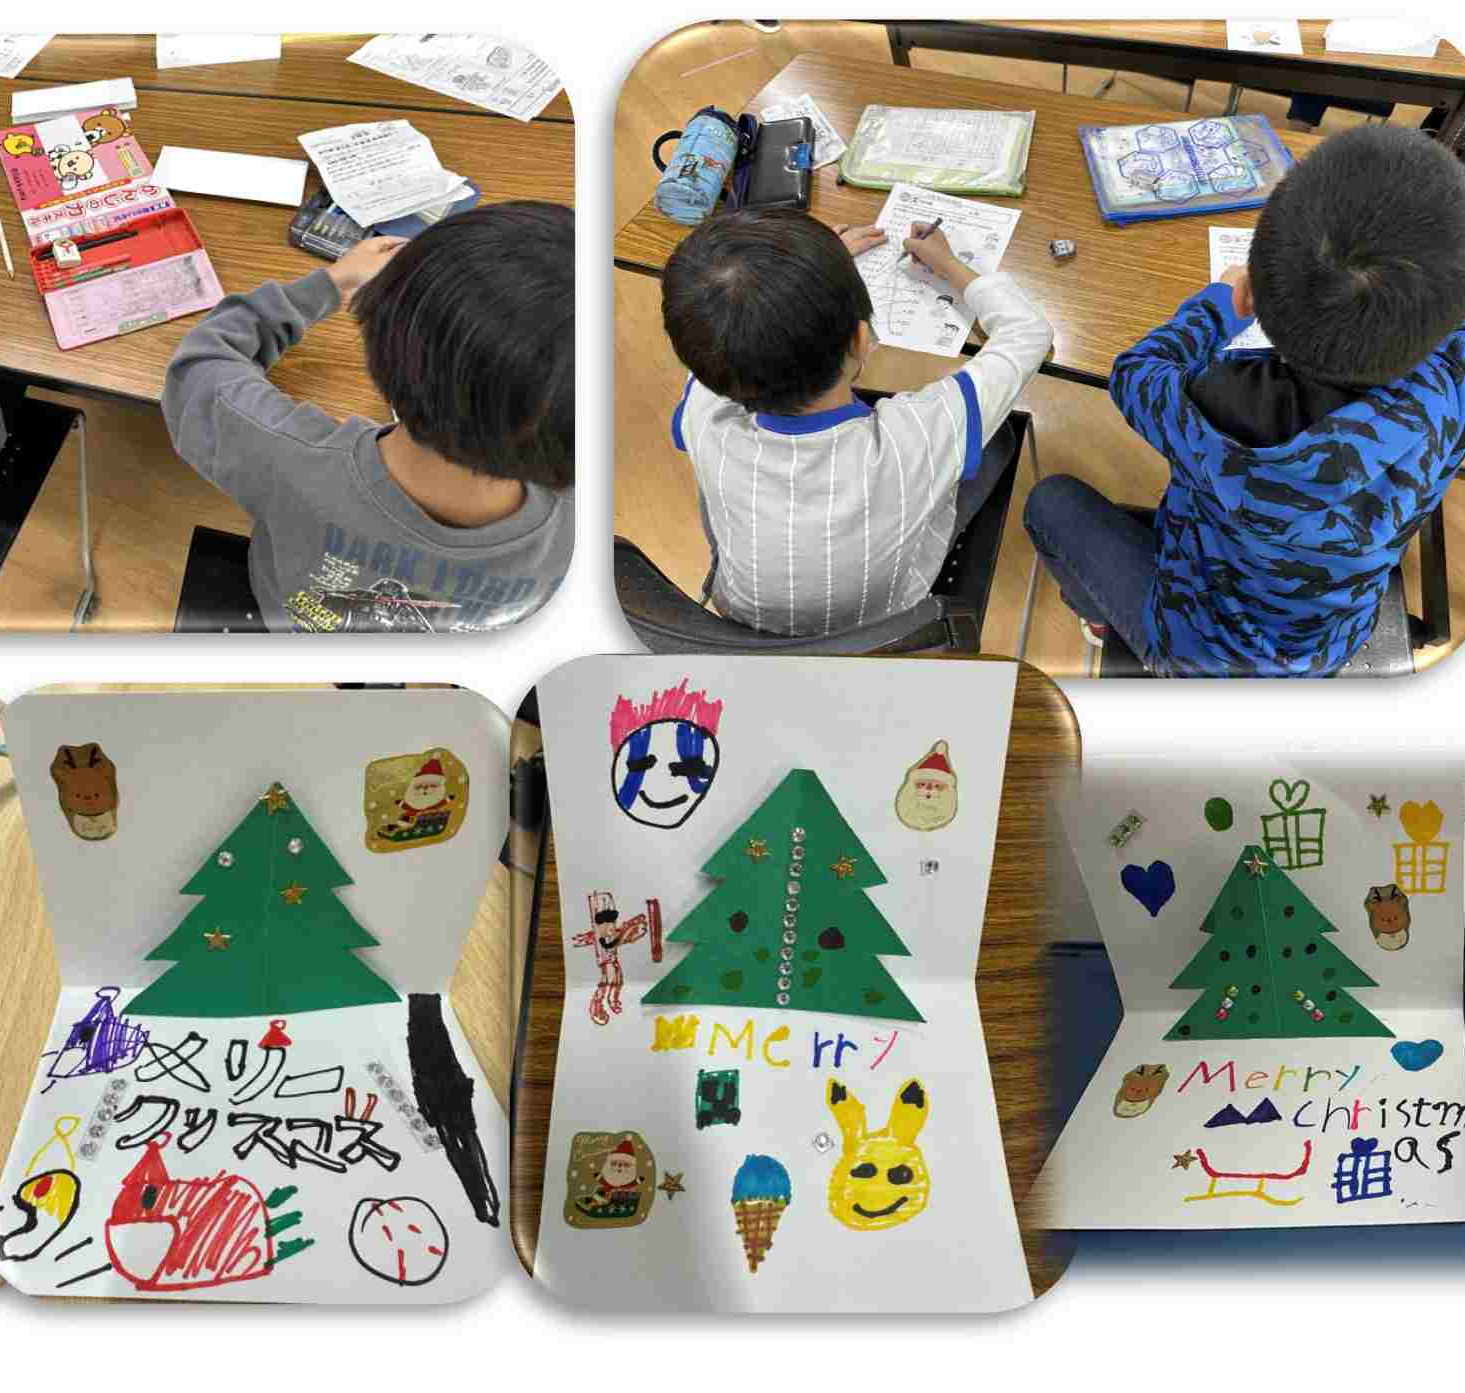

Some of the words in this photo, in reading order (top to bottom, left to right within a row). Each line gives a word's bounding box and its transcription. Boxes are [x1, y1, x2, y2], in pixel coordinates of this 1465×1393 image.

[133, 1031, 346, 1106] メリー
[1177, 1060, 1361, 1093] Merry
[1394, 1130, 1462, 1174] as
